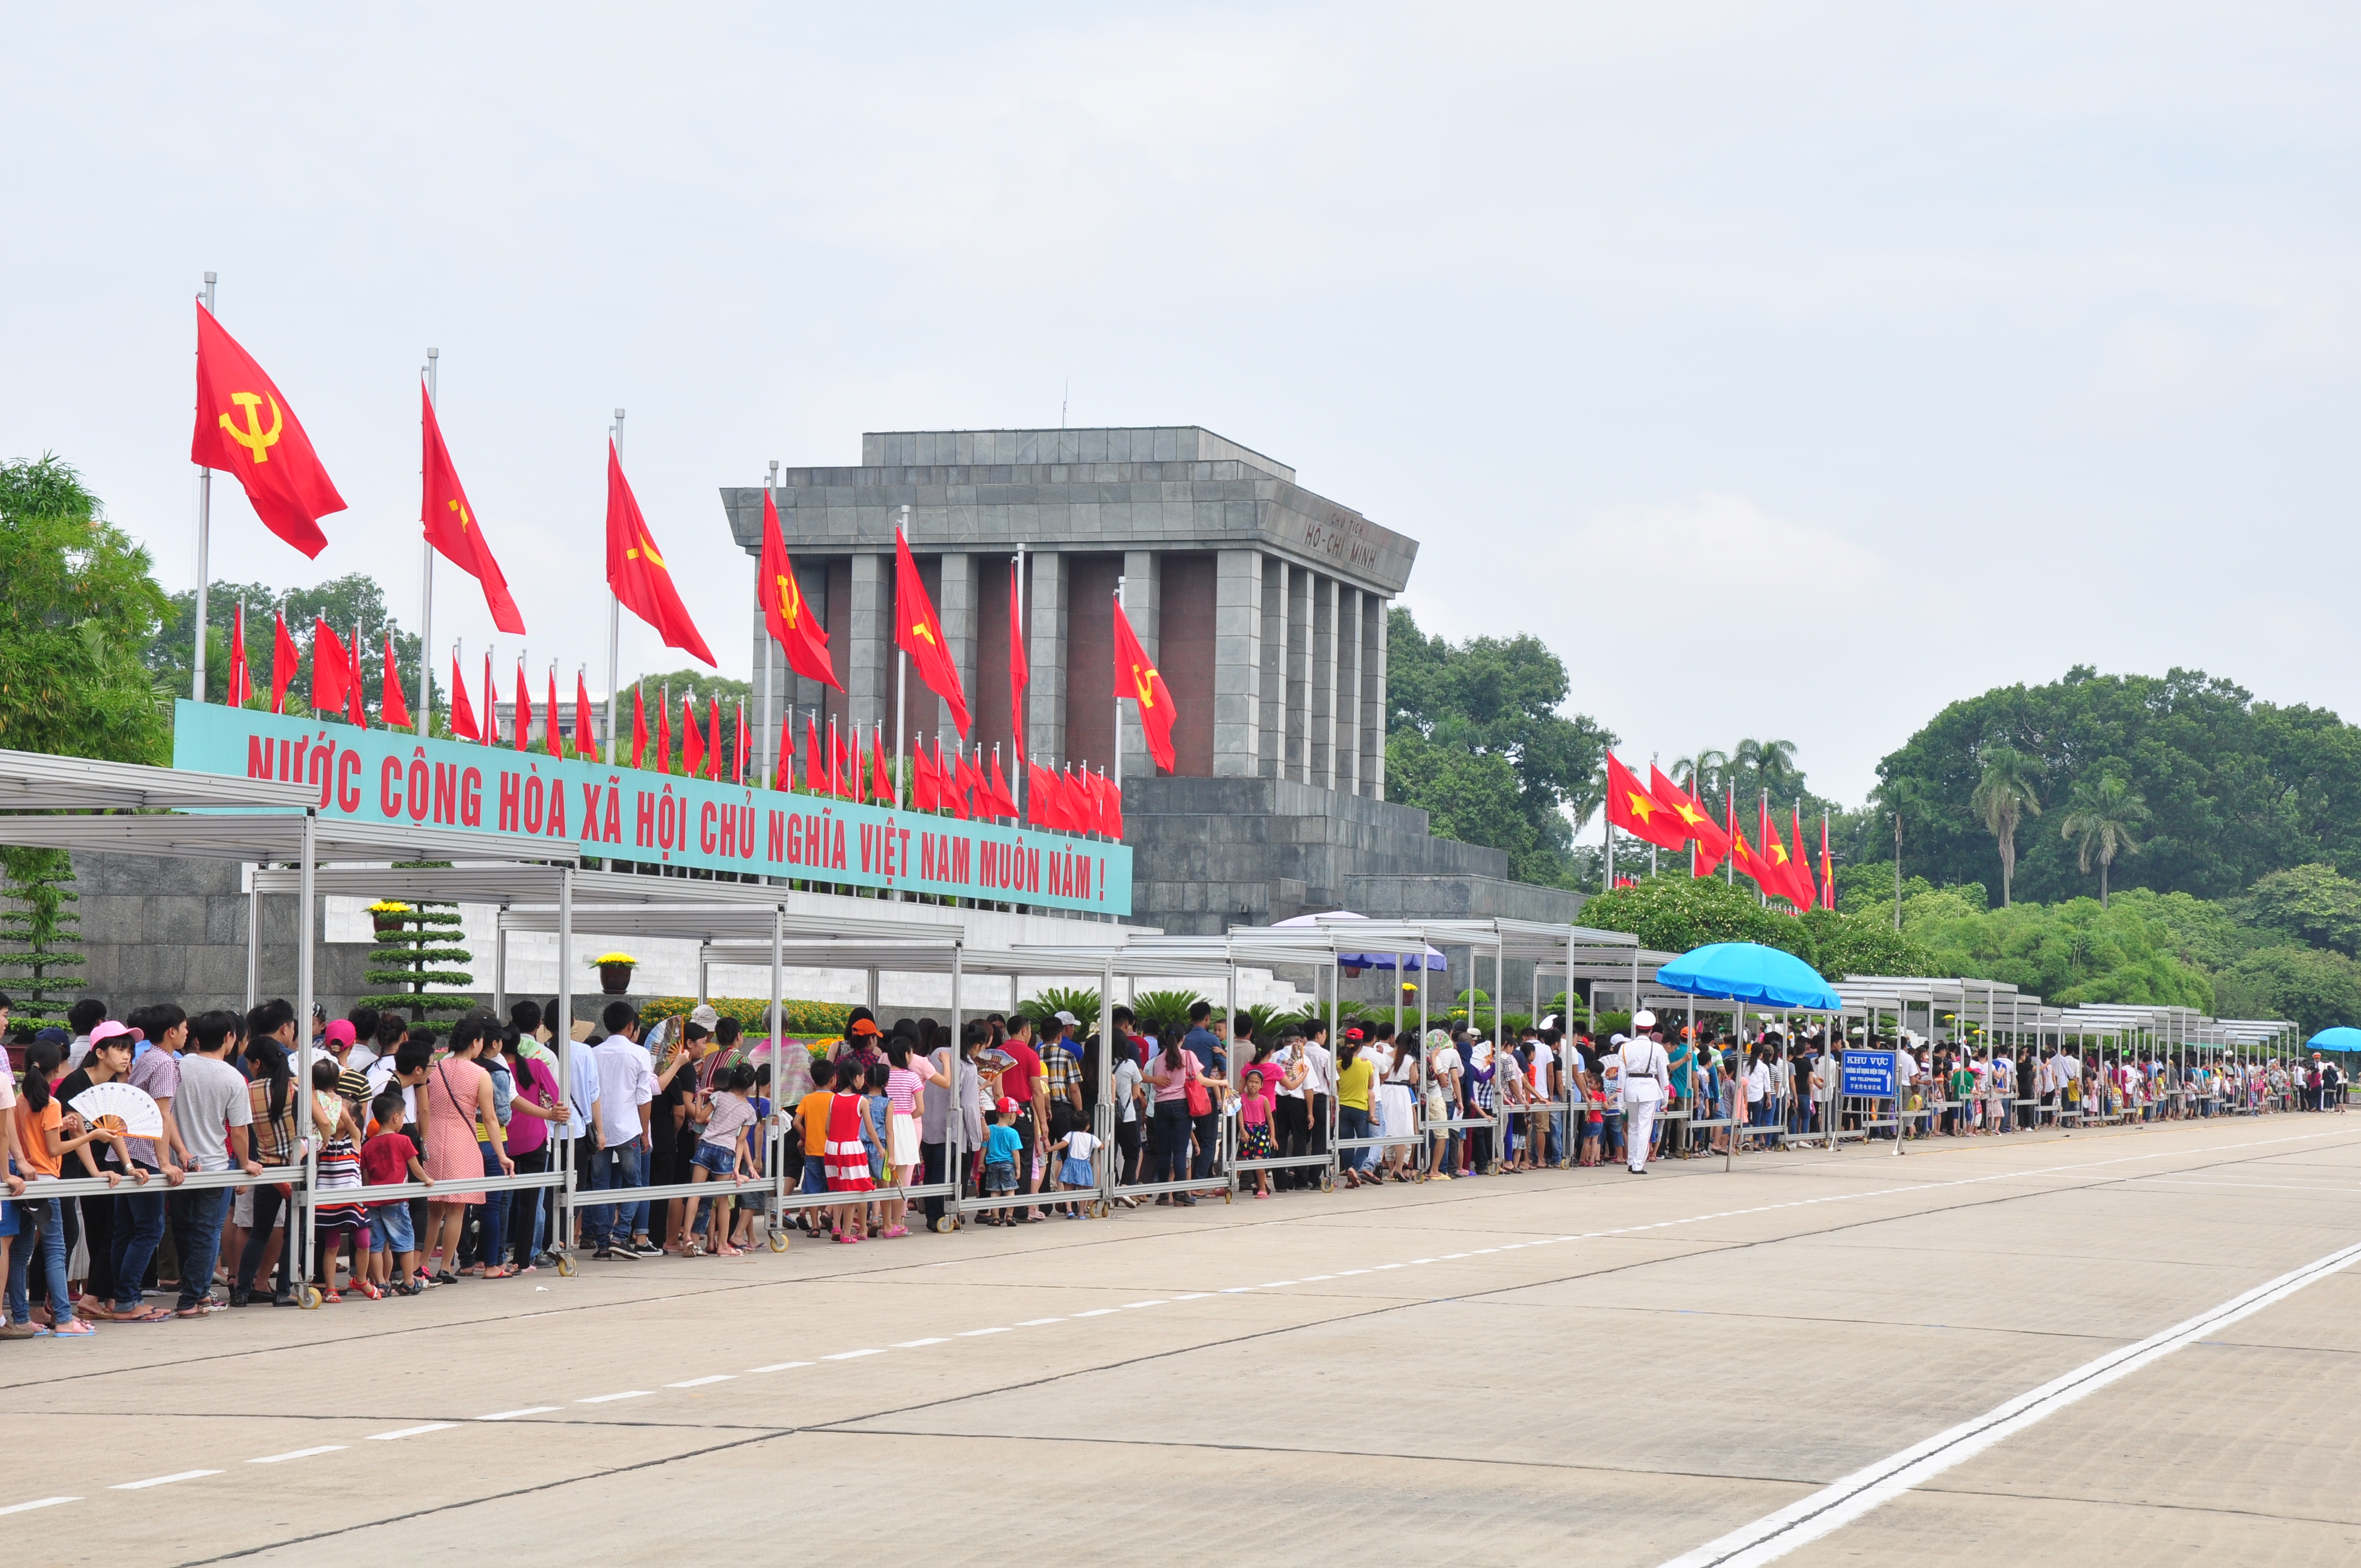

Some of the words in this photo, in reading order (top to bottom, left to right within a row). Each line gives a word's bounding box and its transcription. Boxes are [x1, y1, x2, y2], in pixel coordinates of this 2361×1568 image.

[248, 732, 361, 813] NƯỚC
[381, 747, 482, 827] CỘNG
[499, 763, 566, 837] HÒA
[581, 775, 622, 843] XÃ
[637, 783, 687, 860] HỘI
[700, 790, 755, 859] CHỦ
[768, 807, 846, 870] NGHĨA
[860, 816, 910, 885] VIỆT
[921, 831, 970, 885] NAM
[980, 836, 1040, 893] MUÔN
[1048, 843, 1091, 900] NĂM
[1870, 1057, 1889, 1066] VỰC
